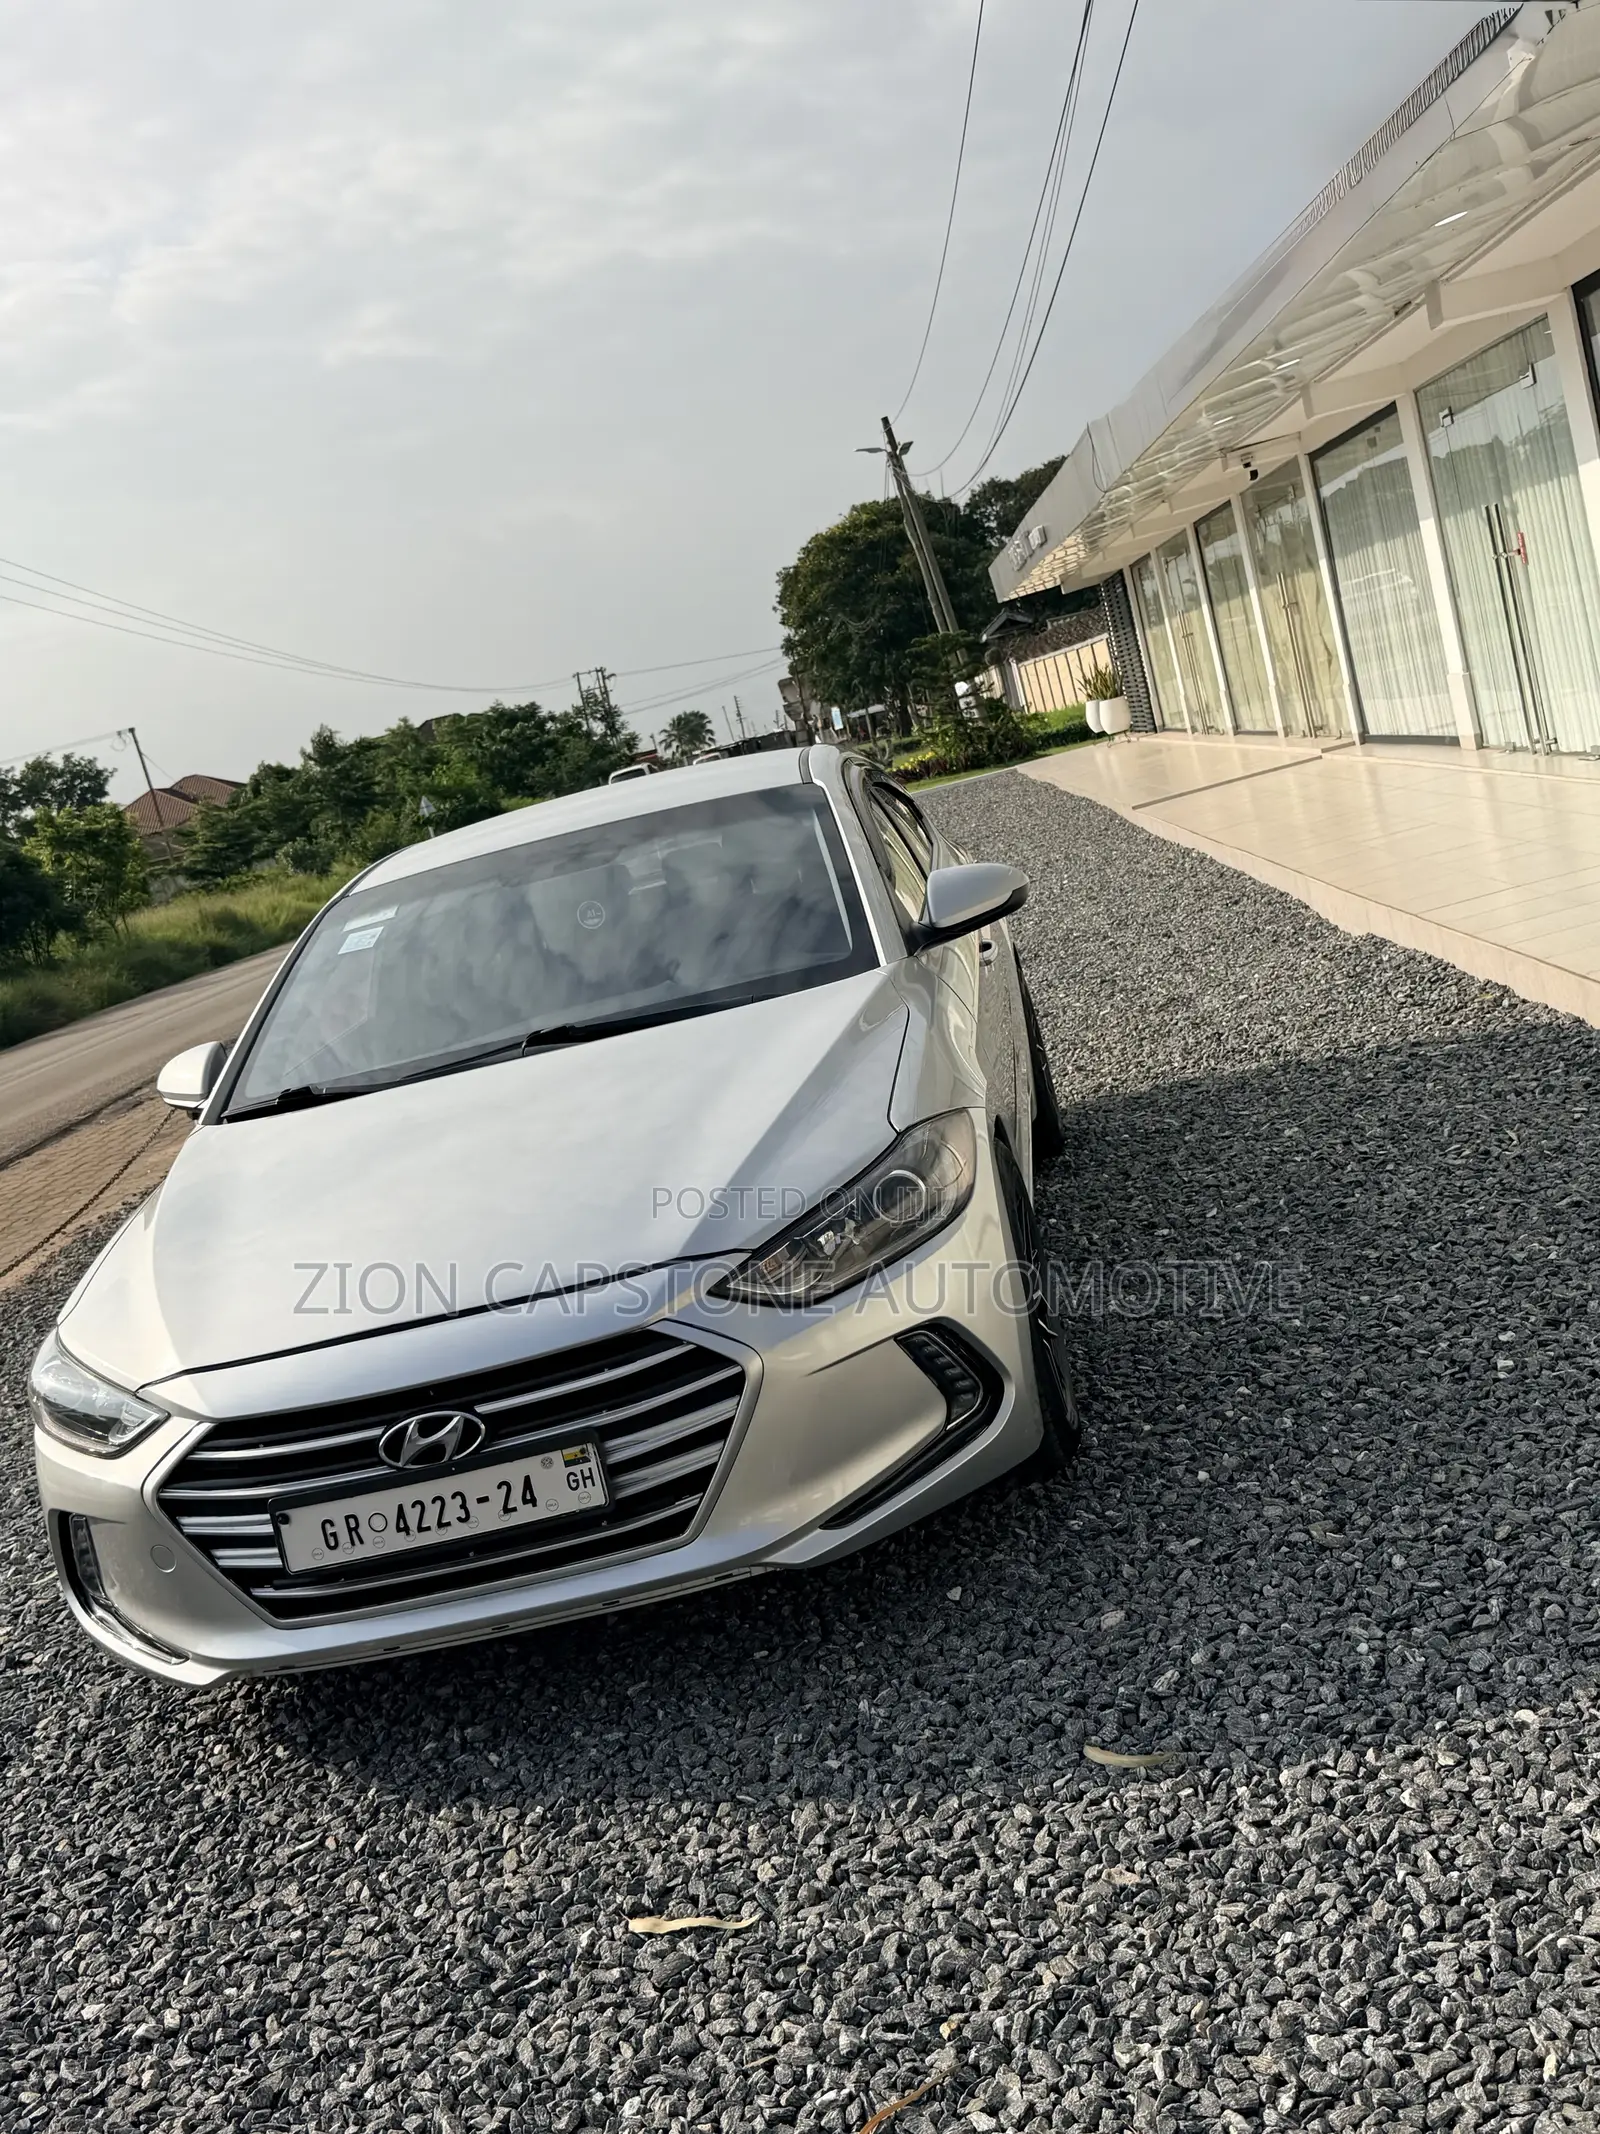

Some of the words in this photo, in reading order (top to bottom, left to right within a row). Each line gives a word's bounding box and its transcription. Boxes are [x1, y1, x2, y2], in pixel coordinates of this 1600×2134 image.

[565, 1466, 596, 1492] GH
[320, 1513, 364, 1551] GR
[395, 1474, 538, 1536] 4223-24
